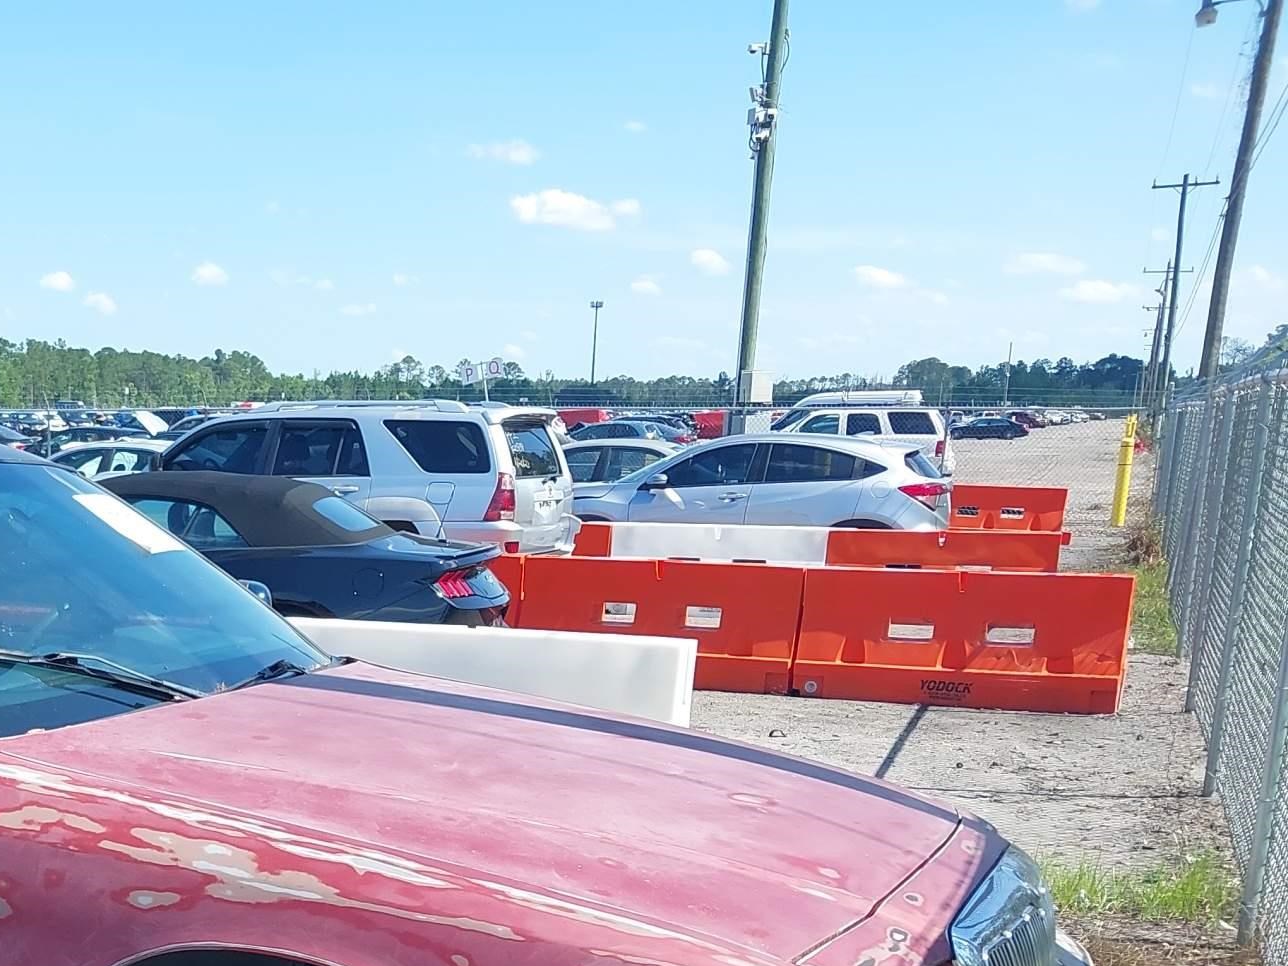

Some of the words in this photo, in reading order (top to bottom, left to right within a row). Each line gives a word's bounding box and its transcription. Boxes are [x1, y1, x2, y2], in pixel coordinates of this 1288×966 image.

[466, 367, 473, 382] P
[488, 360, 501, 375] Q
[920, 679, 974, 694] YODOCK
